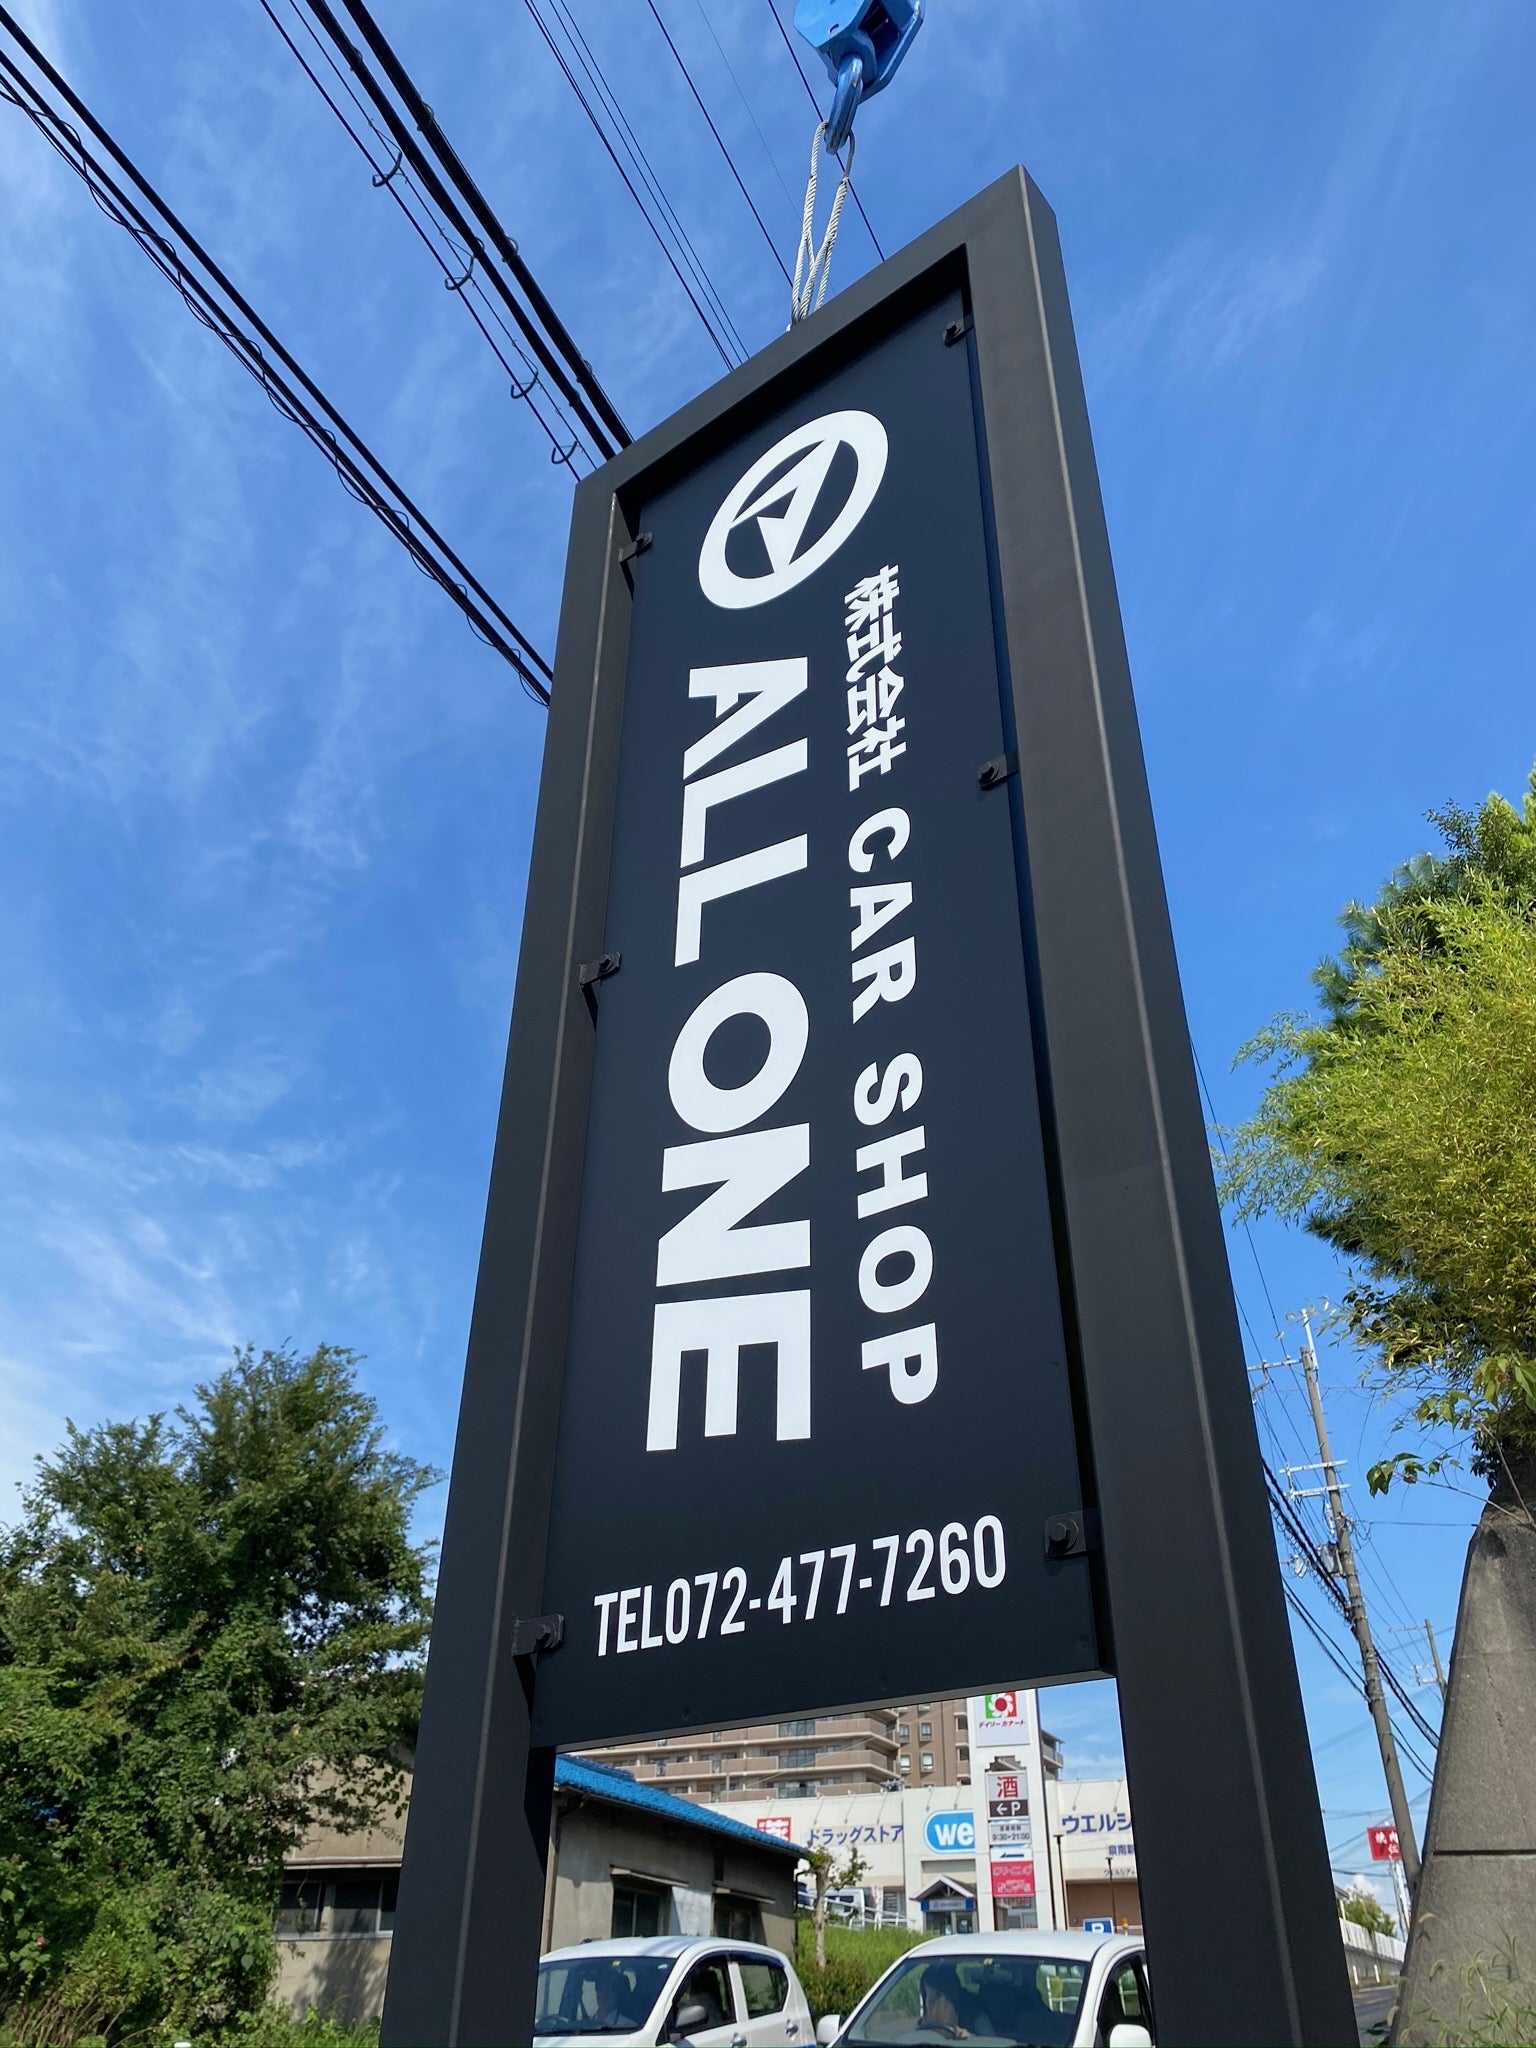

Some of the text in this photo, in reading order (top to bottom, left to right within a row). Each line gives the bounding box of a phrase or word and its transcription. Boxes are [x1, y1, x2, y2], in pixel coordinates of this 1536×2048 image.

[844, 564, 938, 1405] 株式会社 CAR SHOP
[646, 656, 811, 1452] ALLONE
[996, 1776, 1019, 1798] 酒
[1011, 1802, 1021, 1815] P
[808, 1824, 904, 1846] ドラッグストア
[934, 1821, 974, 1847] we
